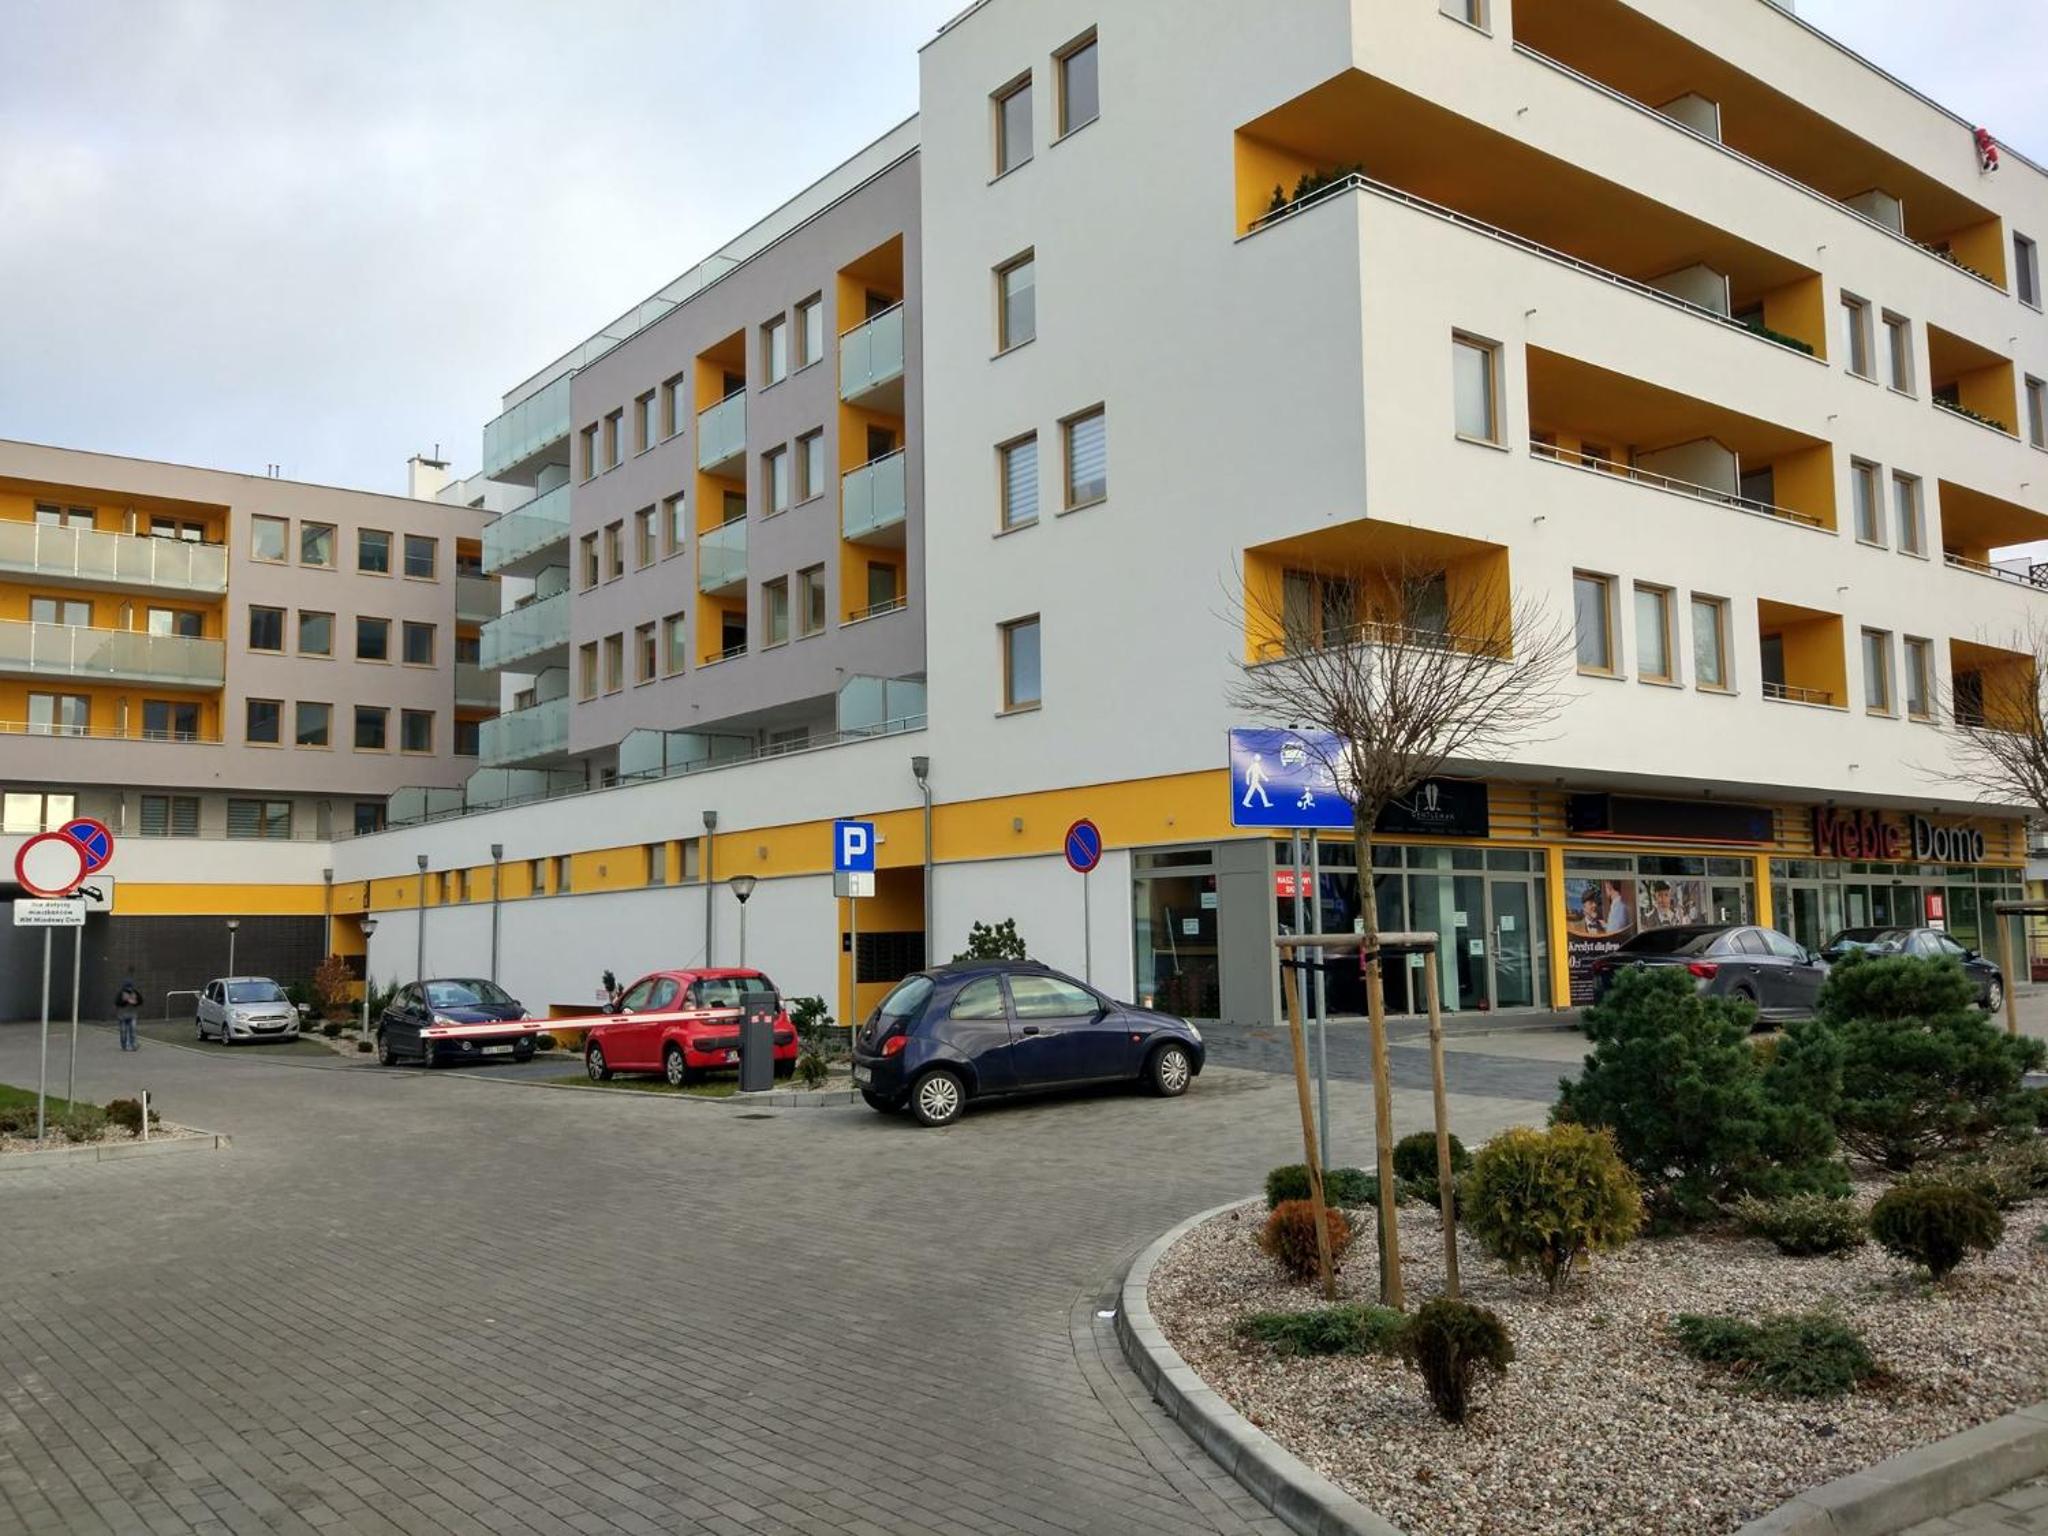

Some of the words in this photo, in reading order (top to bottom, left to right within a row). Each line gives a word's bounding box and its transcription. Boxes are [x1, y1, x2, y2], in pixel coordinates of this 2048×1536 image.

[843, 826, 867, 866] P
[1813, 805, 1901, 859] Meble
[1913, 815, 1985, 863] Domo
[1569, 941, 1594, 954] Kredyt
